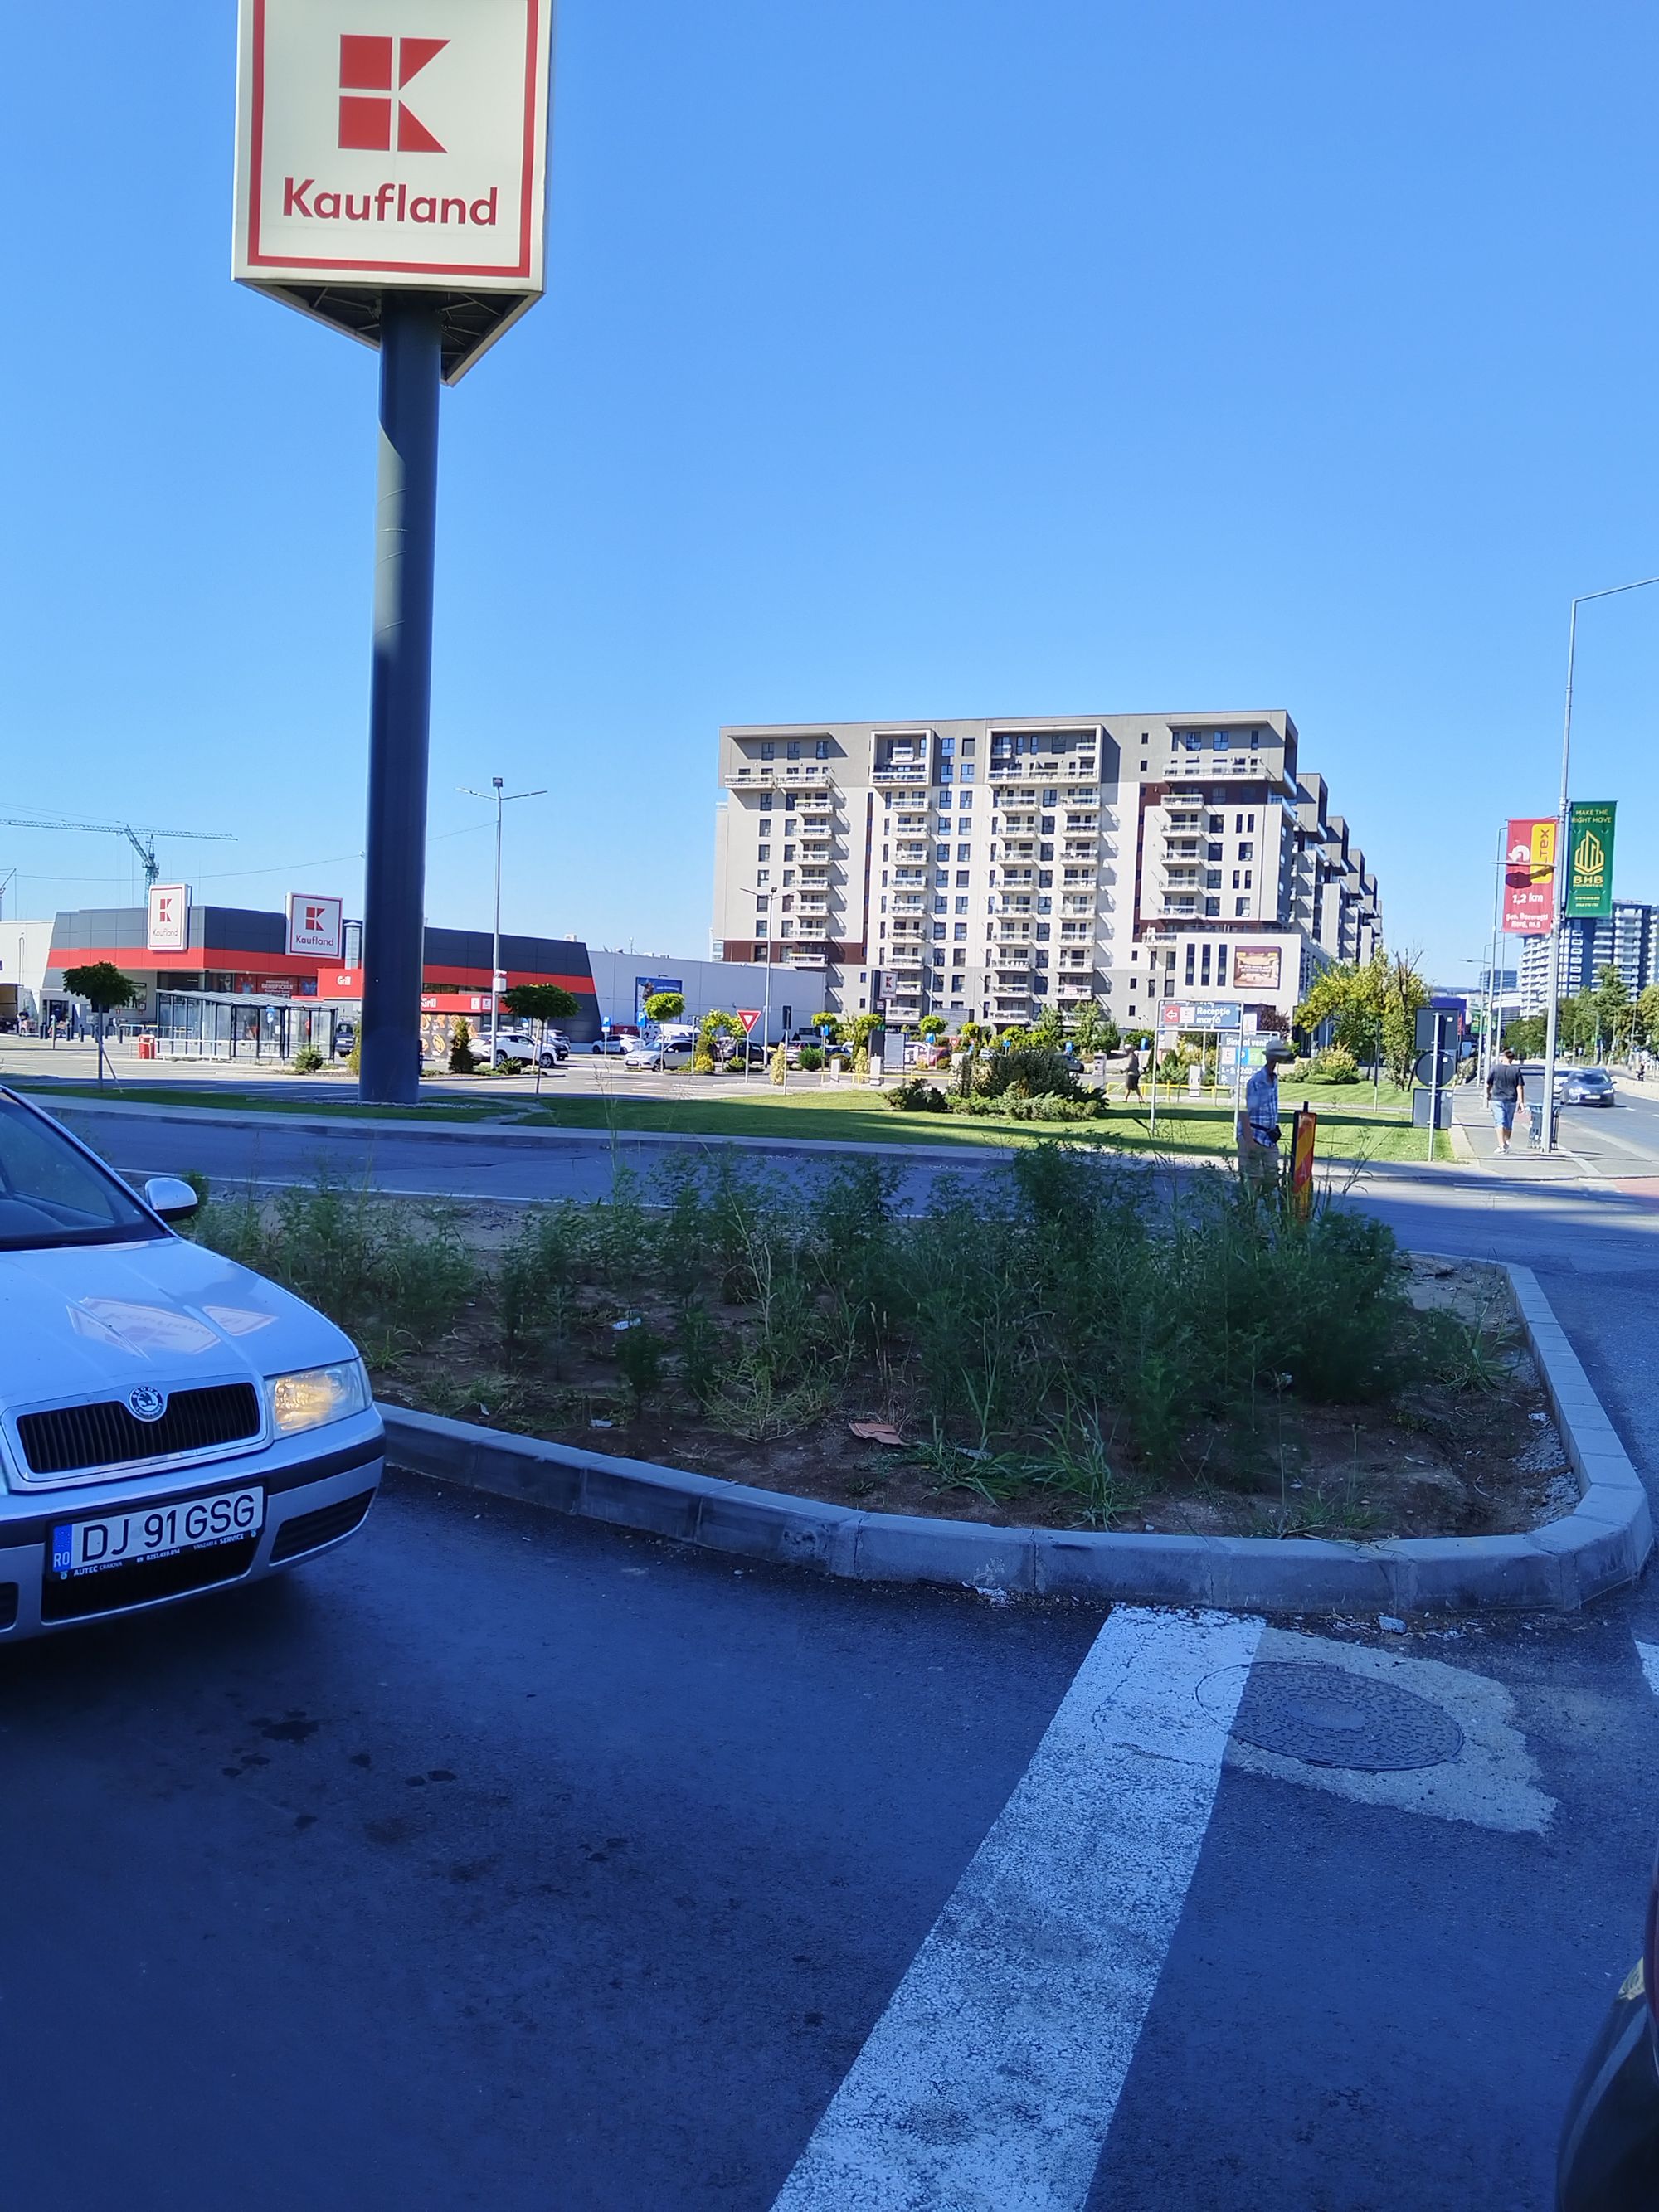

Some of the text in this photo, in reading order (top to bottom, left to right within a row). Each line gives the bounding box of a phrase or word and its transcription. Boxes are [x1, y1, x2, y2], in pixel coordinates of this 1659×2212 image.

[338, 34, 451, 153] K
[283, 177, 498, 226] Kaufland
[1573, 875, 1603, 884] BHB
[1529, 892, 1544, 903] km
[153, 928, 178, 937] Kaufland
[295, 934, 334, 946] Kaufland
[82, 1495, 255, 1562] DJ 91 GSG
[53, 1551, 71, 1568] RO
[74, 1565, 98, 1577] AUTEC
[219, 1533, 244, 1545] SERVICE
